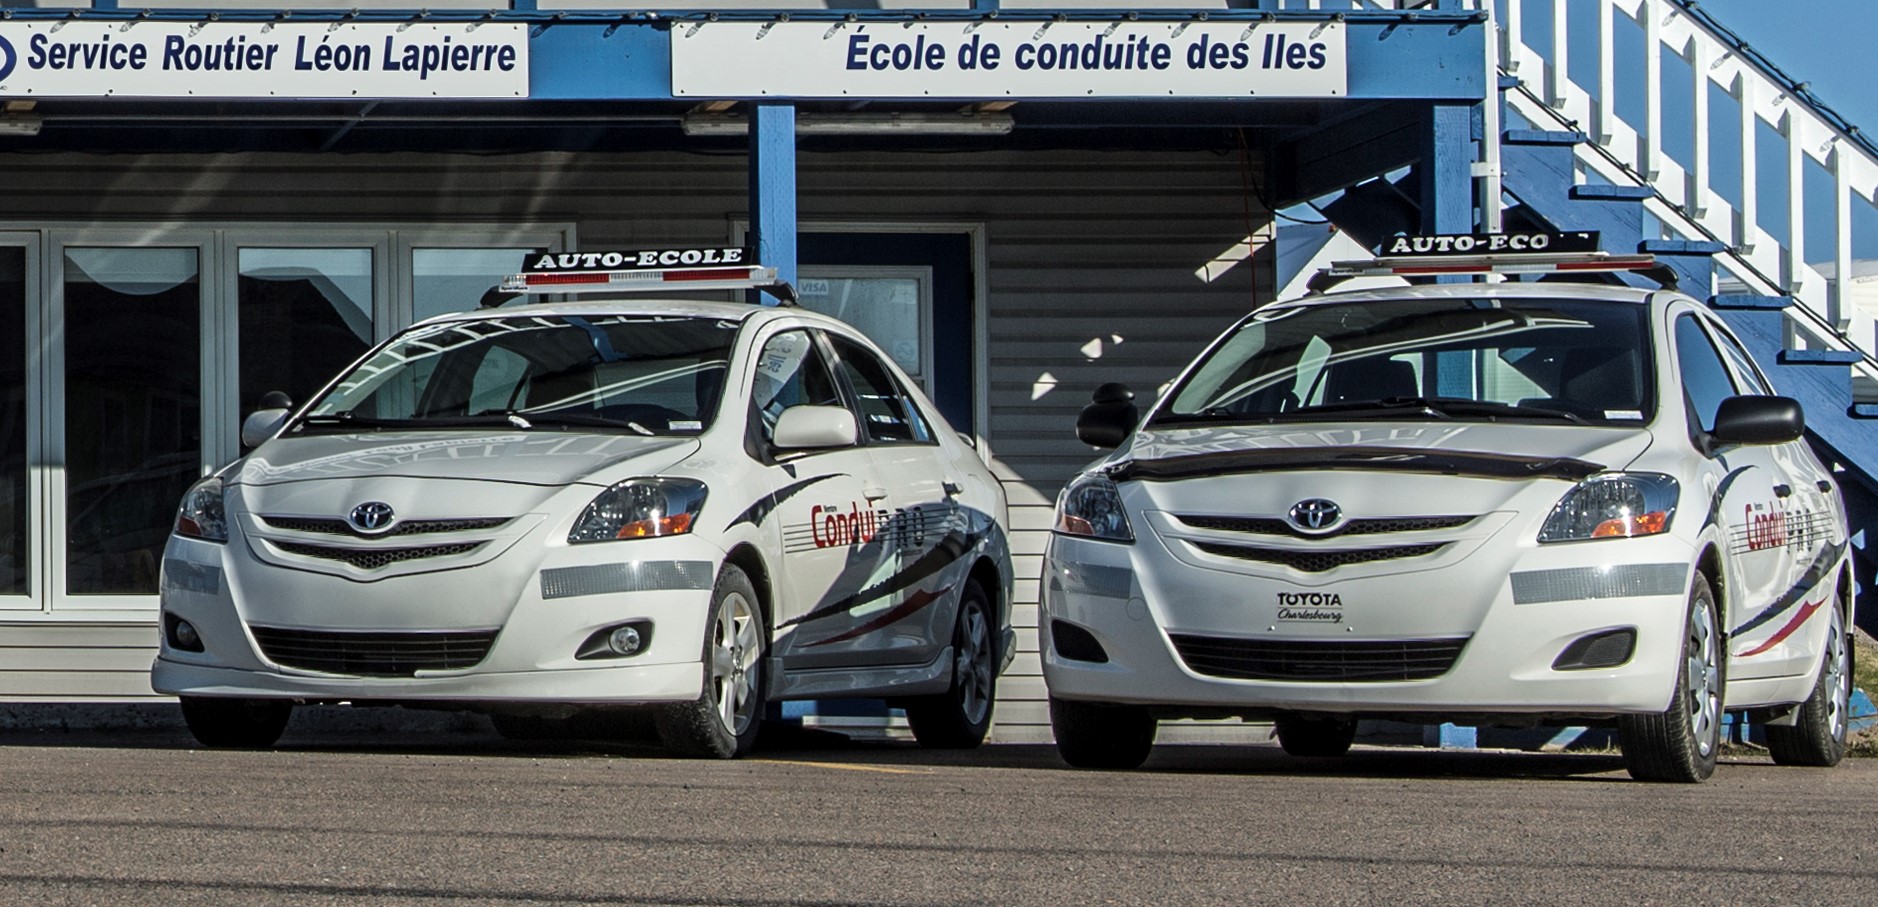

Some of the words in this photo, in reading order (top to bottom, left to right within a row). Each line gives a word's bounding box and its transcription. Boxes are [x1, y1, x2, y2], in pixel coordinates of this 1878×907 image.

[27, 33, 147, 70] Service
[162, 35, 279, 71] Routier
[294, 34, 371, 71] Léon
[383, 35, 516, 81] Lapierre
[846, 25, 946, 71] École
[957, 34, 1001, 70] de
[1014, 33, 1171, 71] conduite
[1186, 33, 1249, 70] des
[1262, 33, 1327, 69] Iles
[1390, 233, 1589, 253] AUTO-ECO
[533, 248, 743, 269] AUTO-ECOLE
[801, 282, 827, 292] VISA
[1277, 592, 1343, 606] TOYOTA
[1277, 607, 1344, 624] Charlesbourg
